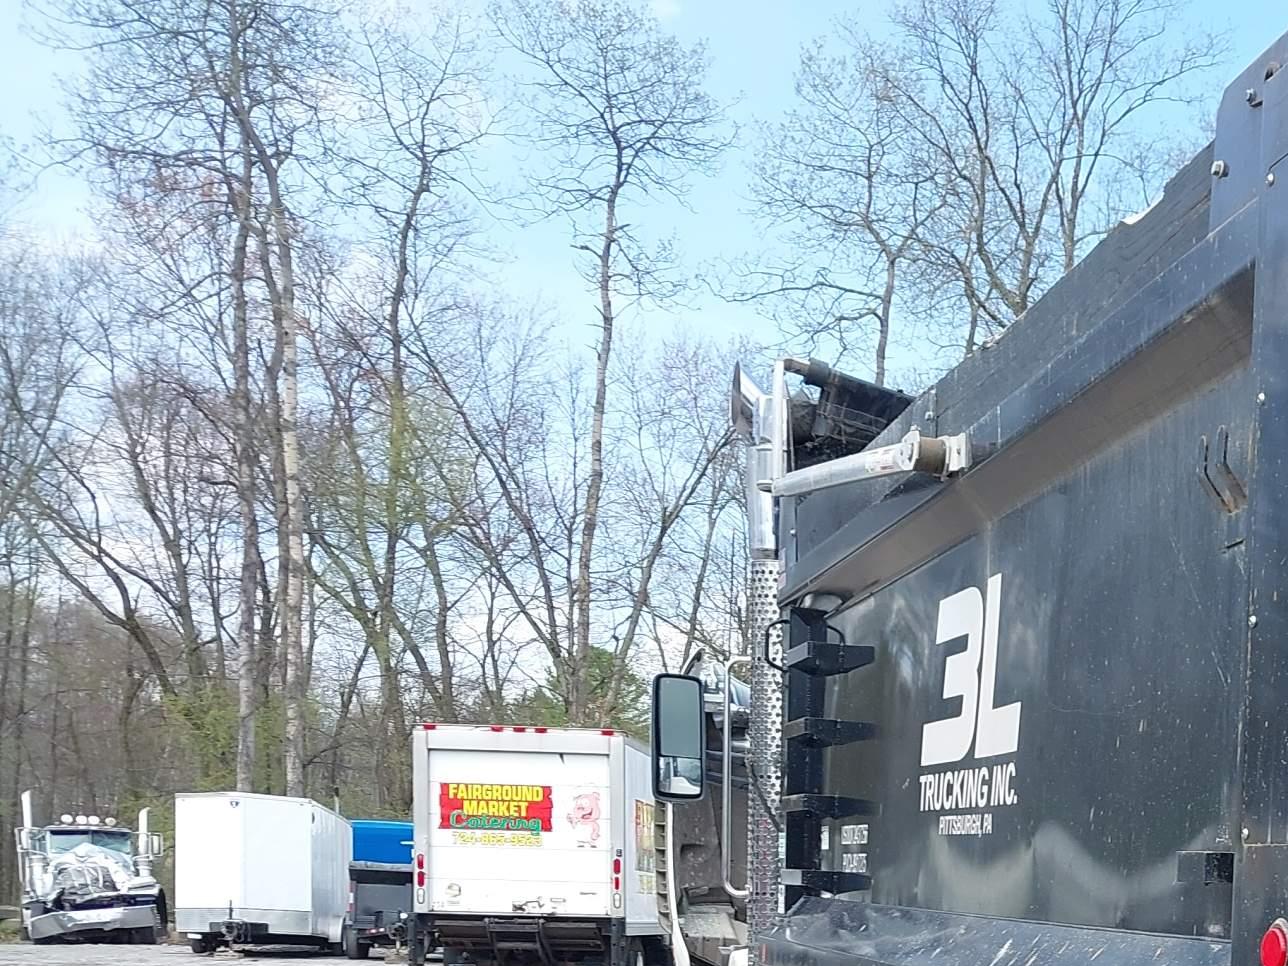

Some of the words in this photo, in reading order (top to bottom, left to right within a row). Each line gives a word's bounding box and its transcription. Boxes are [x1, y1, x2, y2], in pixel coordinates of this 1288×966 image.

[920, 573, 1021, 766] 3L
[448, 783, 544, 802] FAIRGROUND
[919, 767, 988, 811] TRUCKING
[990, 762, 1018, 806] INC.
[463, 800, 529, 818] MARKET
[450, 809, 542, 836] Catering
[983, 813, 993, 834] PA
